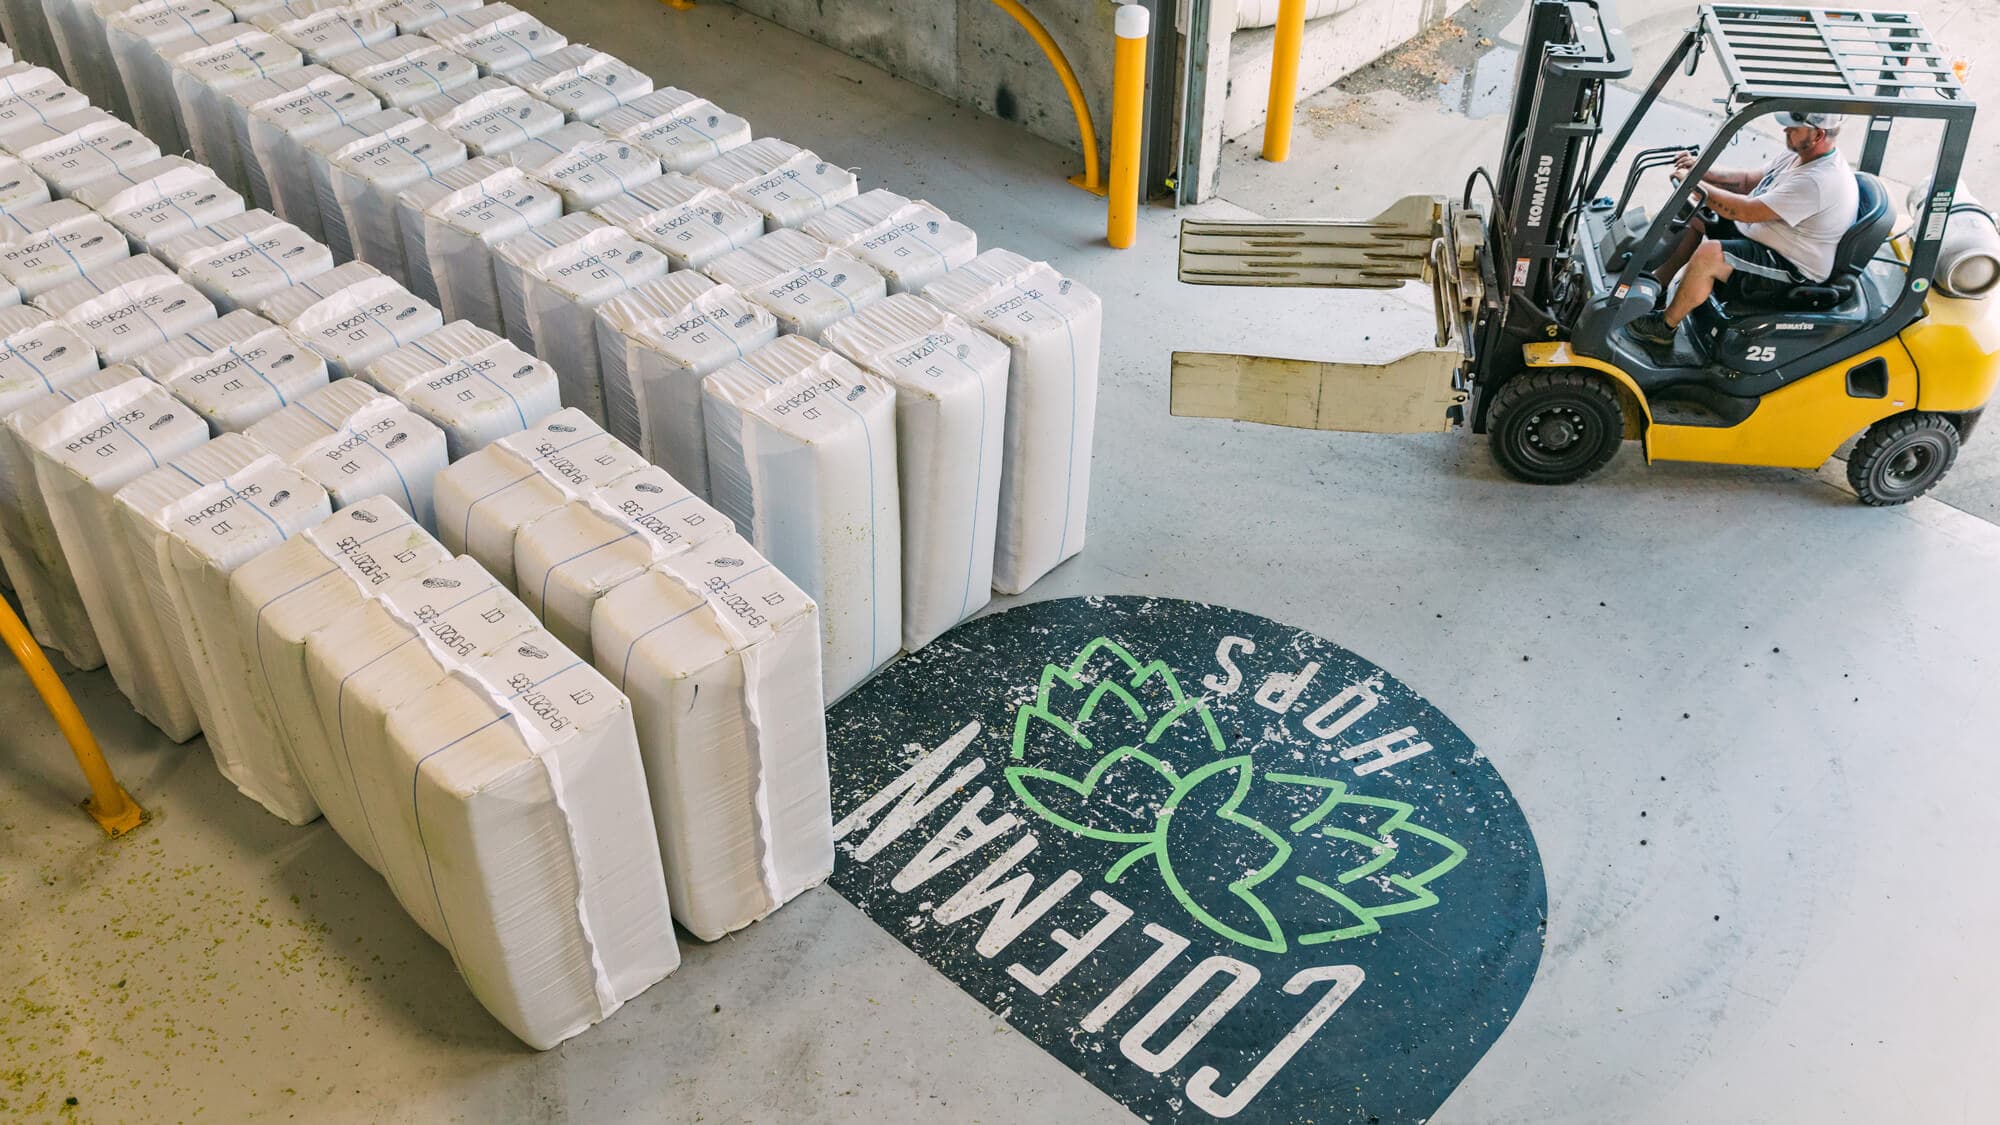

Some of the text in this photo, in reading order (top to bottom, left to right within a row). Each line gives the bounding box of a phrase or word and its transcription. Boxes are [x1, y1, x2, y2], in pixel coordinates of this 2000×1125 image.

[484, 124, 502, 135] CIT
[62, 159, 80, 169] CIT
[373, 156, 391, 166] CIT
[578, 173, 595, 183] CIT
[774, 191, 791, 201] CIT
[1527, 155, 1553, 227] KOMATSU
[150, 212, 169, 223] CIT
[478, 211, 496, 221] CIT
[676, 231, 694, 241] CIT
[24, 257, 43, 269] CIT
[231, 266, 251, 278] CIT
[591, 268, 609, 280] CIT
[793, 293, 812, 305] CIT
[112, 323, 131, 335] CIT
[1776, 322, 1814, 330] KOMATSU
[348, 329, 368, 341] CIT
[691, 331, 710, 344] CIT
[1745, 345, 1776, 362] 25
[925, 366, 945, 378] CIT
[223, 379, 244, 392] CIT
[457, 389, 476, 402] CIT
[802, 407, 823, 420] CIT
[96, 443, 118, 457] CIT
[594, 454, 616, 466] CIT
[341, 460, 361, 474] CIT
[683, 513, 705, 527] CIT
[211, 521, 234, 536] CIT
[394, 548, 416, 564] CIT
[762, 591, 785, 607] CIT
[481, 607, 505, 624] CIT
[569, 688, 595, 705] CIT
[1204, 635, 1433, 777] HOPS
[833, 720, 1367, 1118] COLEMAN
